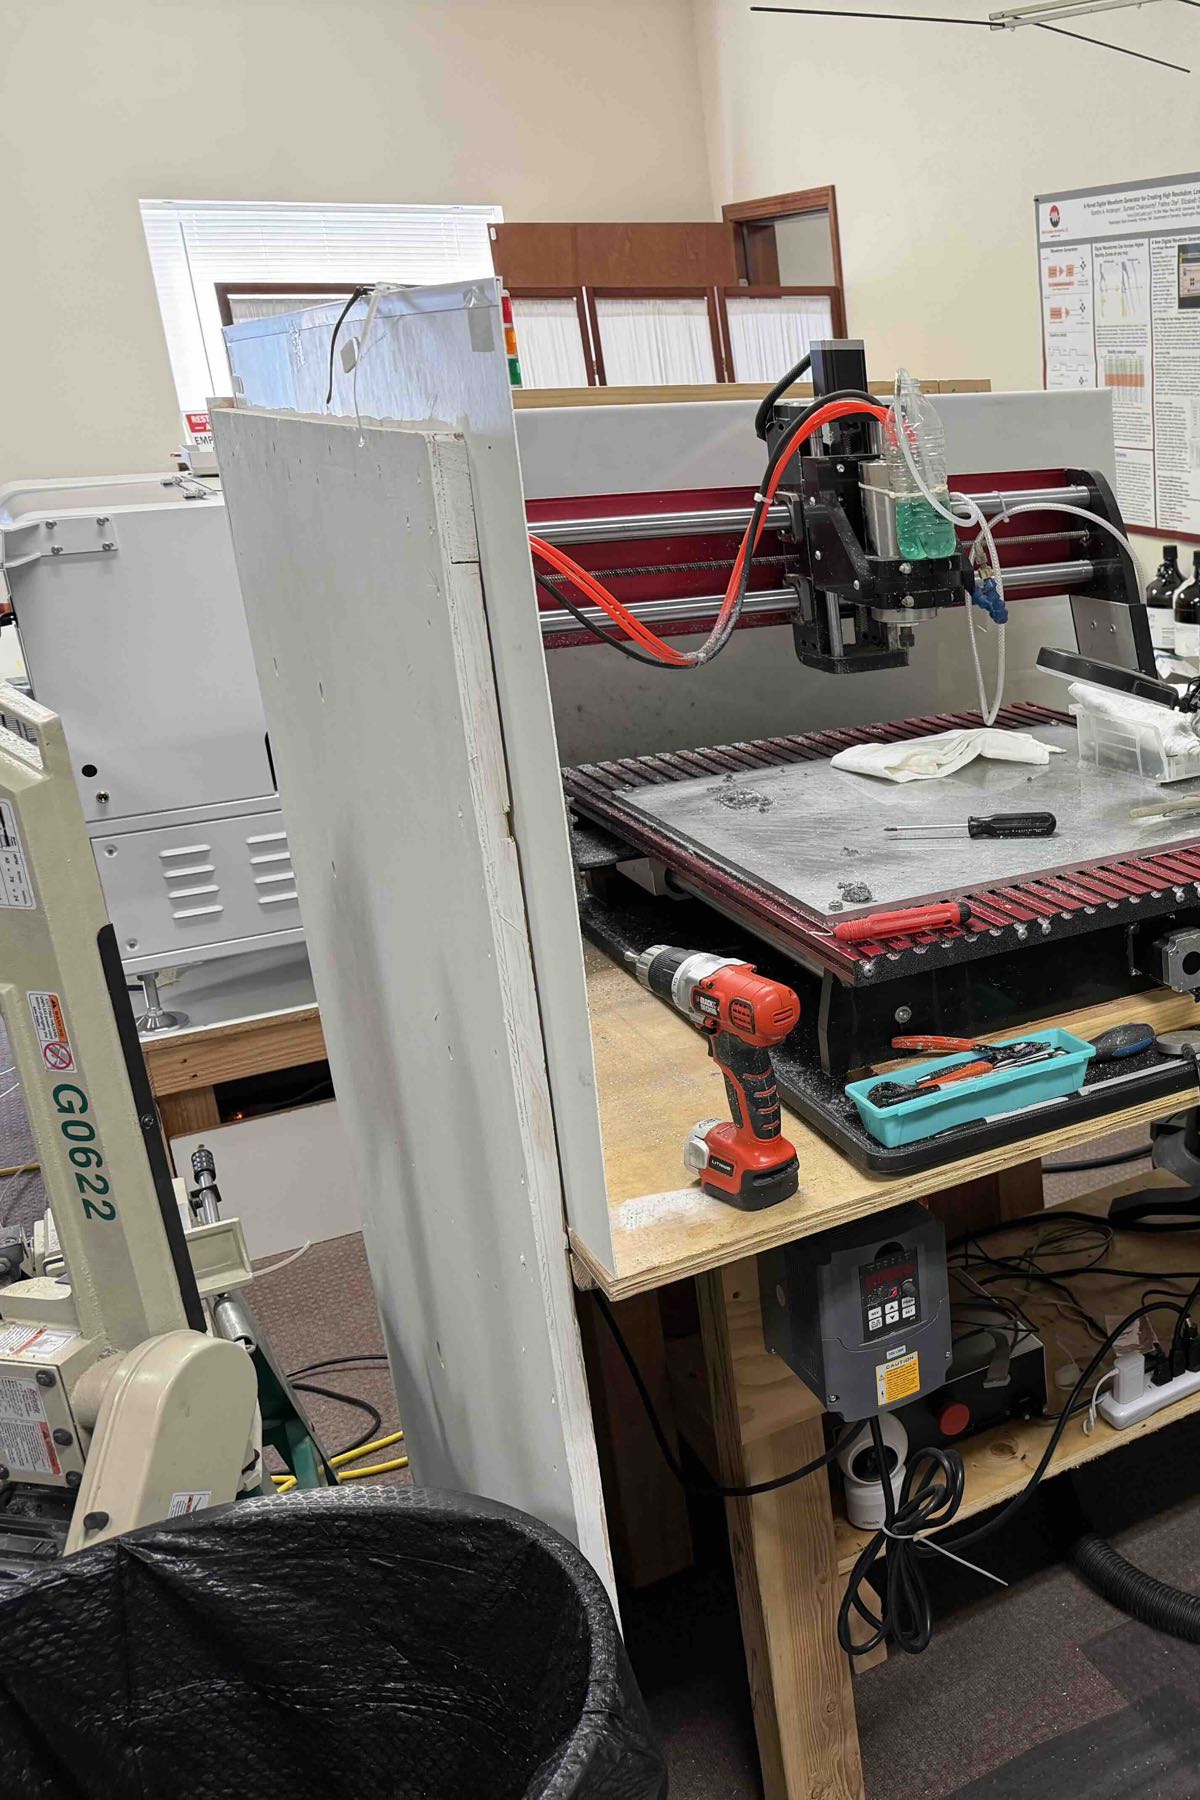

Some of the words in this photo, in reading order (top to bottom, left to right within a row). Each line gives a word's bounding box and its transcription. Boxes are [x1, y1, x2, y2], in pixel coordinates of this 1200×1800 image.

[54, 1010, 64, 1038] WARNING
[52, 1083, 116, 1221] G0622
[885, 1356, 914, 1370] CAUTION
